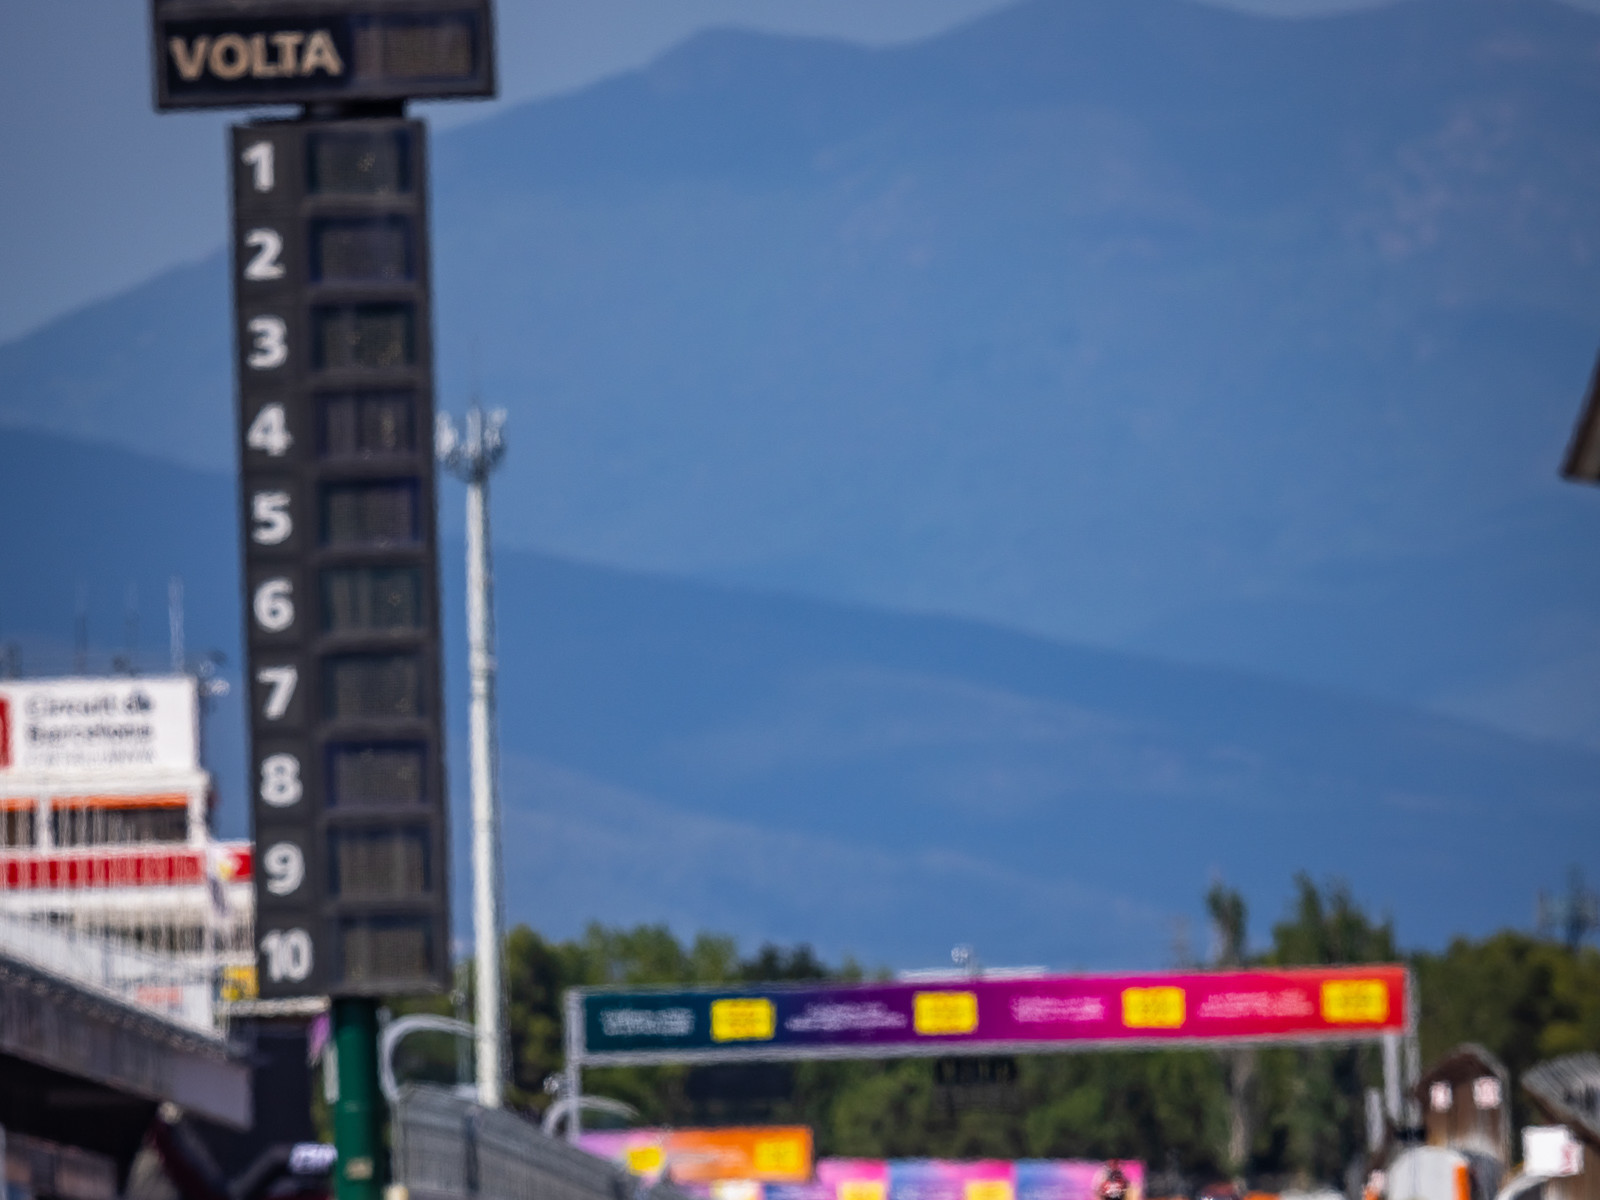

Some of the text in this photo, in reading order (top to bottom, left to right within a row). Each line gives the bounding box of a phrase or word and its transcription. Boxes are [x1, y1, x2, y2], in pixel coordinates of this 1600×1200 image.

[169, 30, 344, 80] VOLTA
[241, 141, 276, 192] 1
[244, 228, 285, 281] 2
[247, 315, 288, 369] 3
[247, 403, 292, 456] 4
[251, 491, 294, 545] 5
[253, 577, 295, 632] 6
[257, 665, 298, 720] 7
[260, 753, 303, 808] 8
[263, 841, 305, 896] 9
[259, 928, 314, 982] 10
